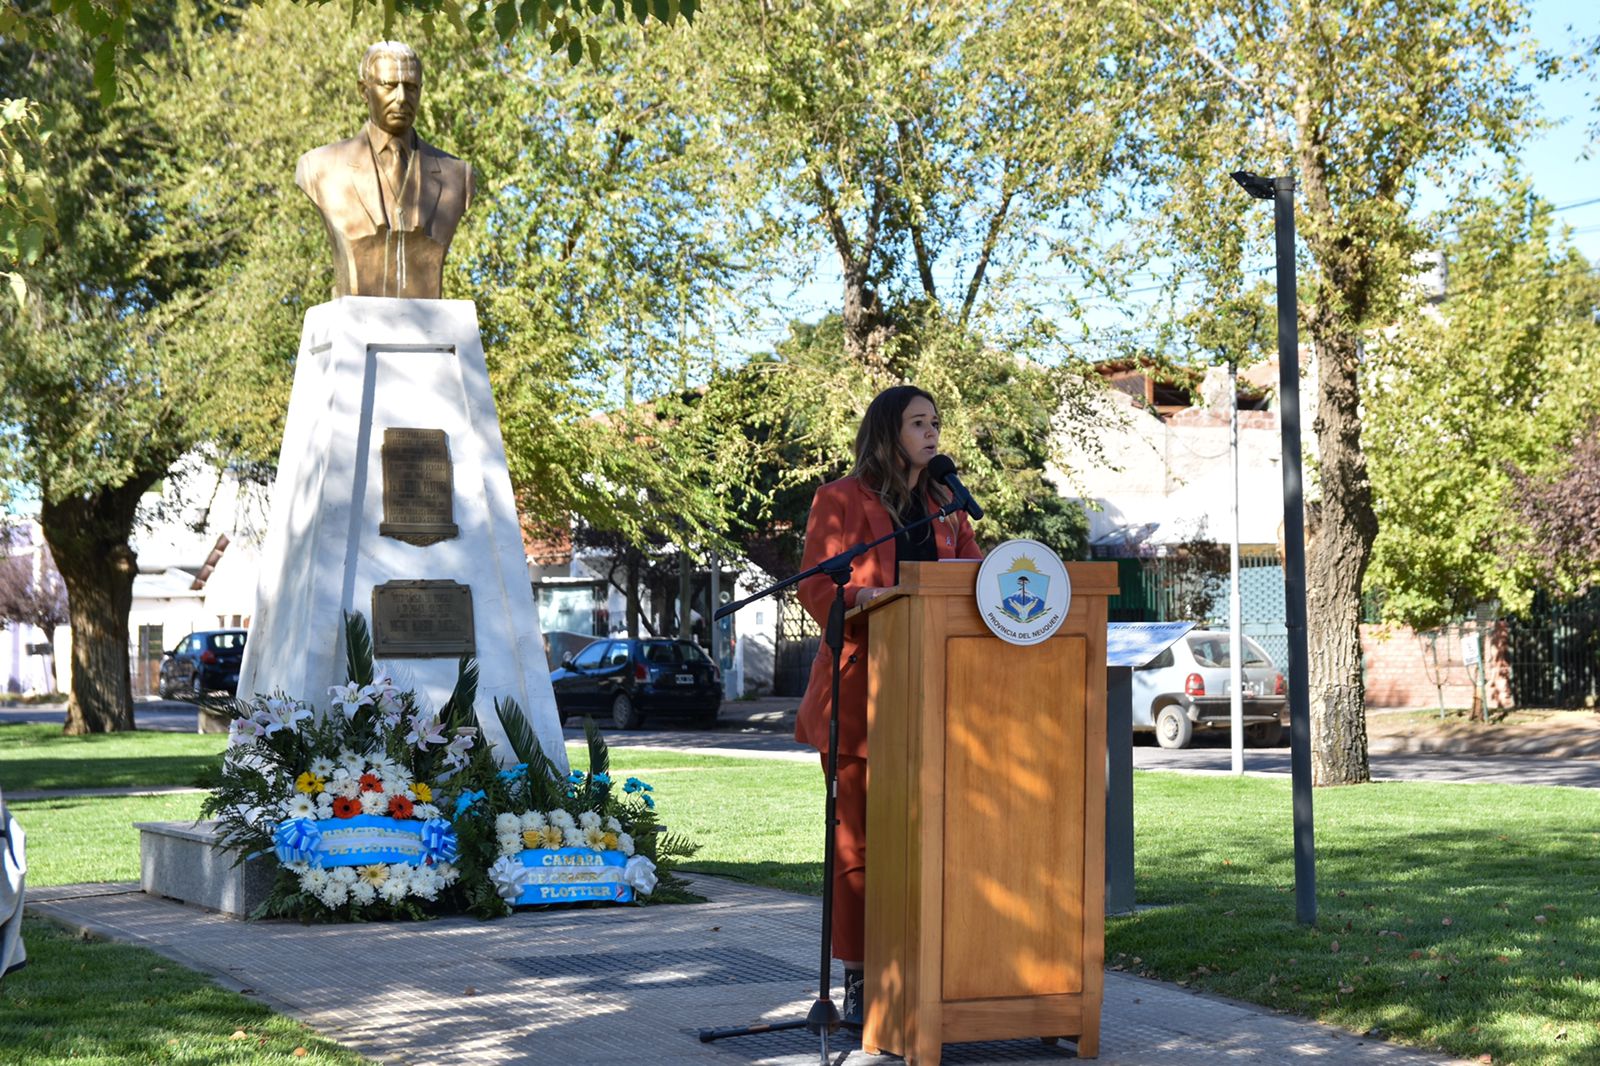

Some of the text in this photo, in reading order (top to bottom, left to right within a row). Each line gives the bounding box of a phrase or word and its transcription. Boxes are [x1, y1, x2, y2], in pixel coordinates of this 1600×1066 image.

[988, 612, 1017, 638] PROVINCIA
[528, 872, 546, 884] DE
[540, 885, 611, 898] PLOTTIER
